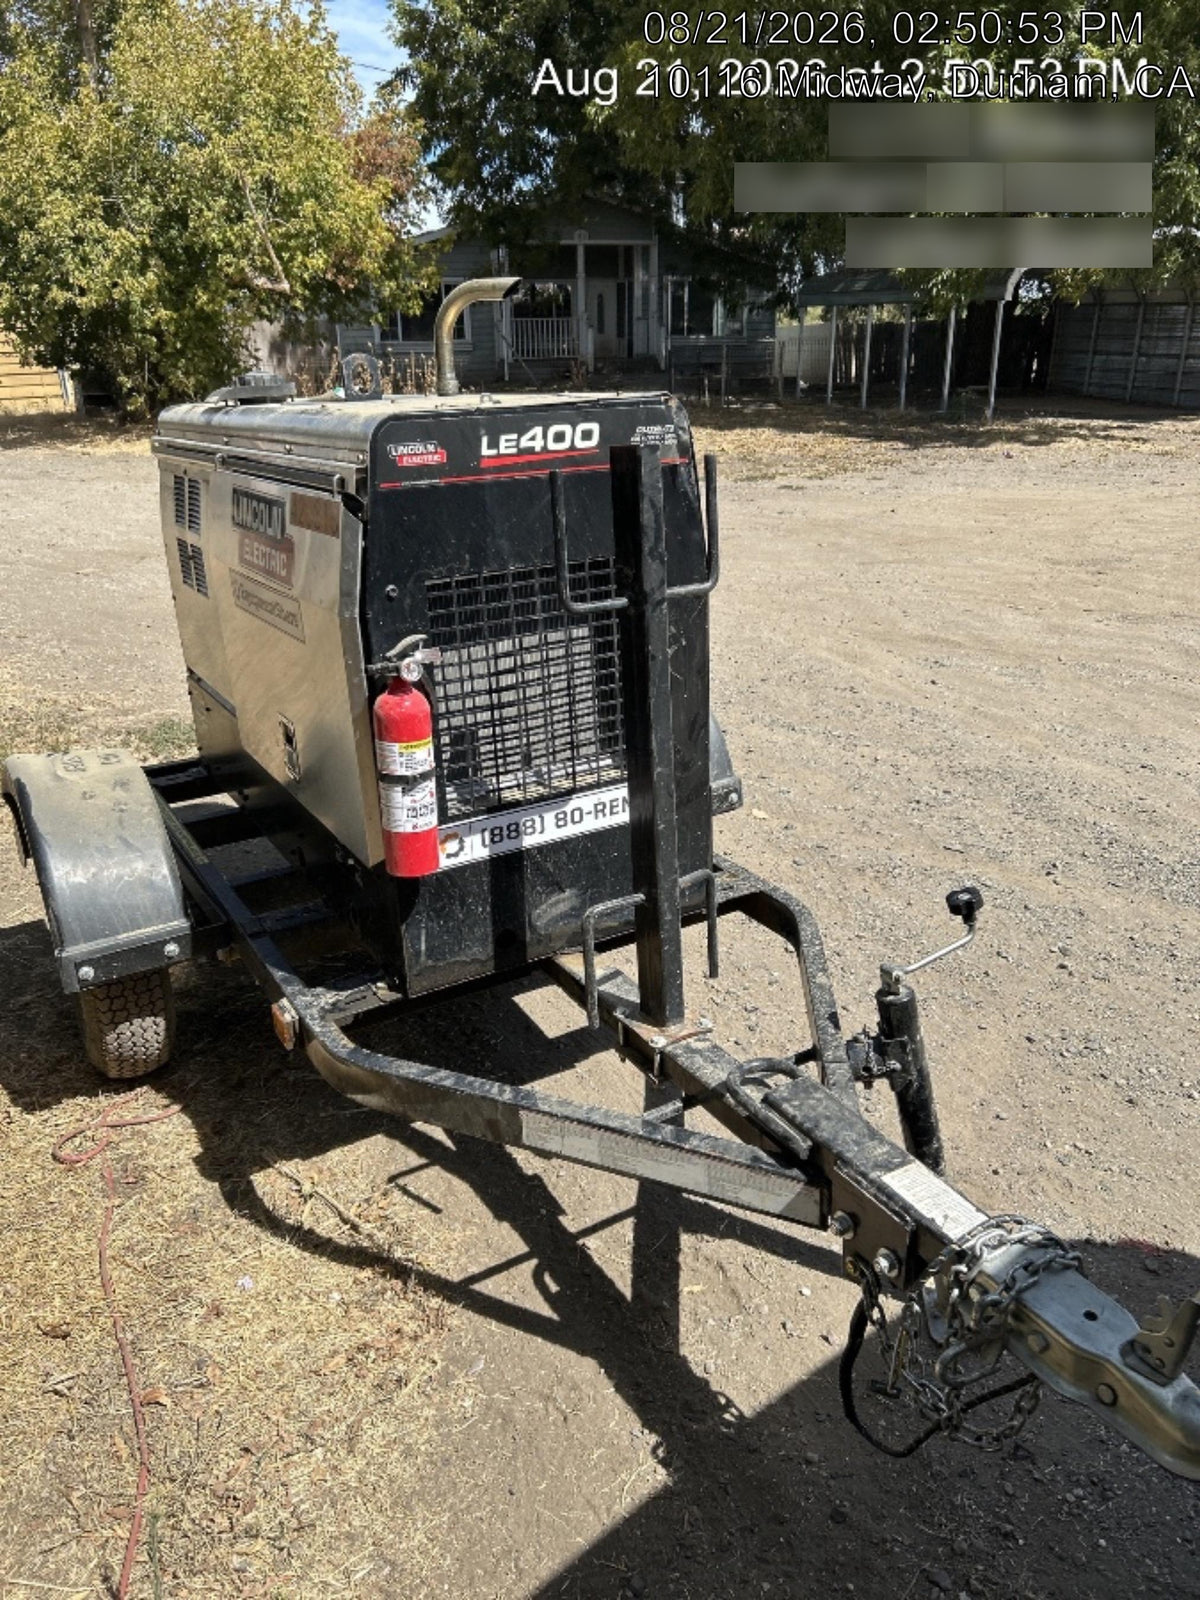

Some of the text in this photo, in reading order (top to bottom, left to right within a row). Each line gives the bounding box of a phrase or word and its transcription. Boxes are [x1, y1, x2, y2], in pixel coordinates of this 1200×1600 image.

[390, 443, 436, 456] LINCOLN
[481, 422, 600, 456] LE400
[402, 454, 442, 465] ELECTRIC
[233, 492, 283, 540] LINCOLN
[244, 538, 288, 578] ELECTRIC
[481, 813, 545, 848] (888)
